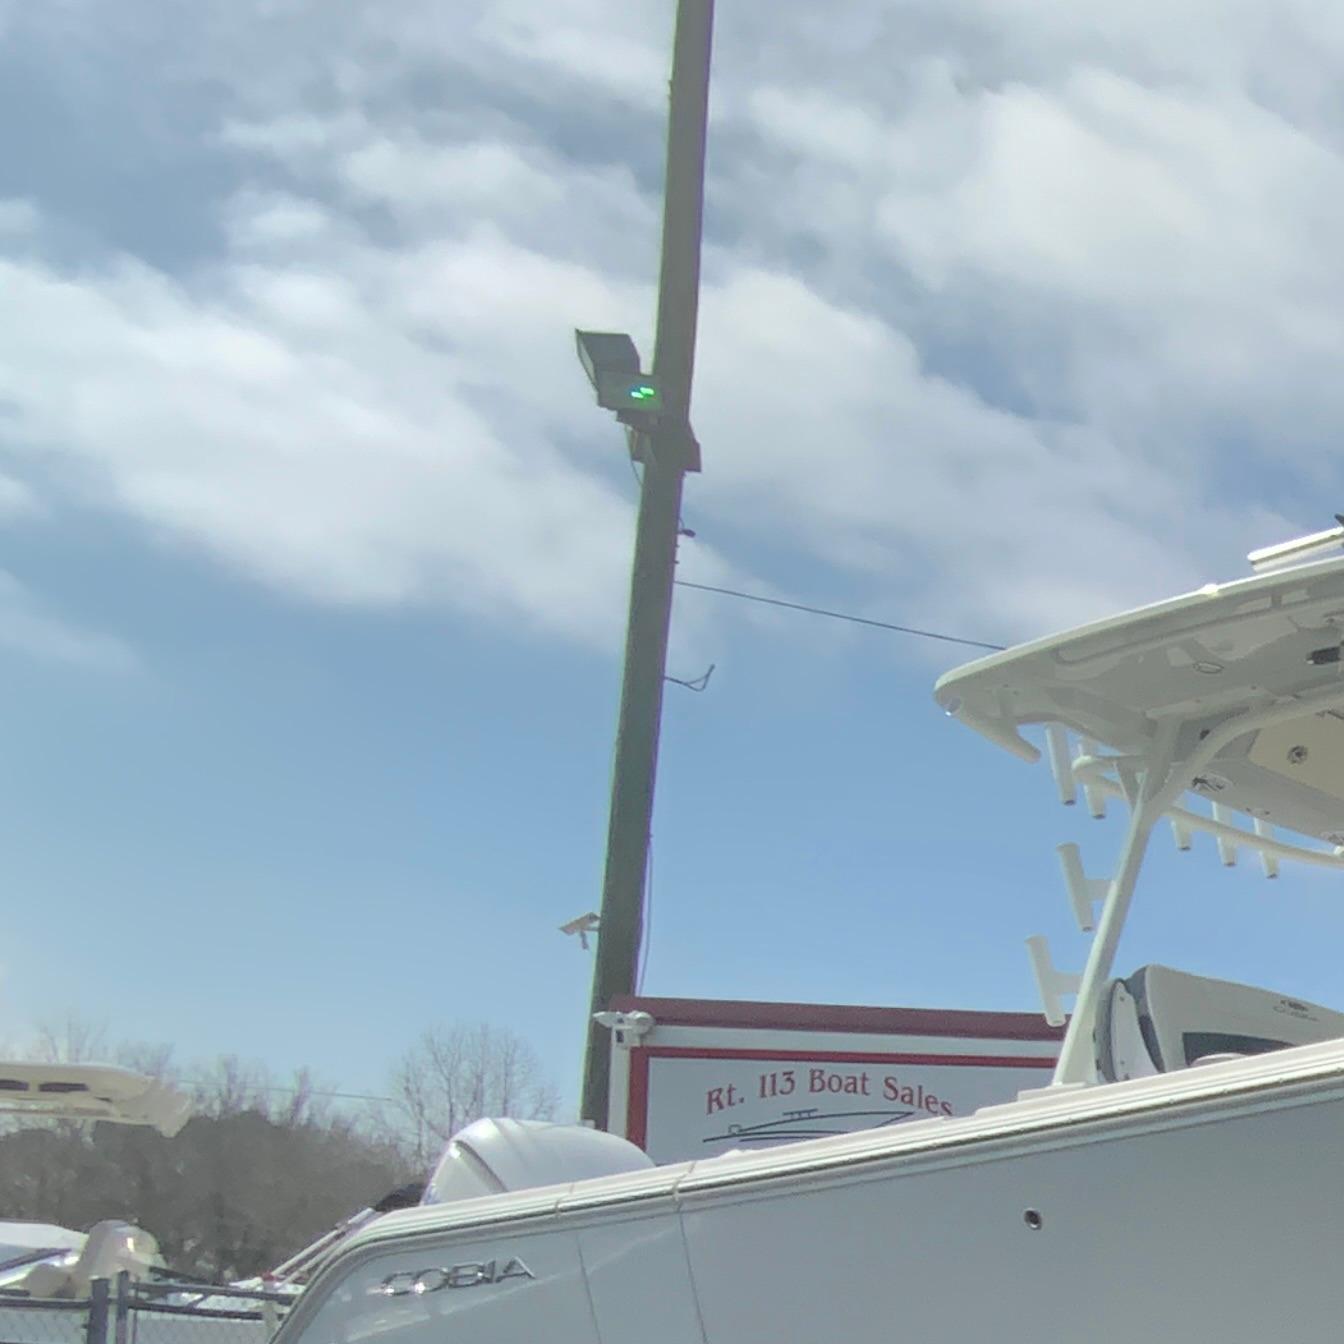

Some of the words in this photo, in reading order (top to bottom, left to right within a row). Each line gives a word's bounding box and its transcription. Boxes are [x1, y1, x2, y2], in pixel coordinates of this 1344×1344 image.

[706, 1083, 745, 1116] Rt.
[759, 1070, 796, 1099] 113
[808, 1068, 871, 1096] Boat
[883, 1076, 953, 1116] Sales
[381, 1256, 536, 1297] COBIA
